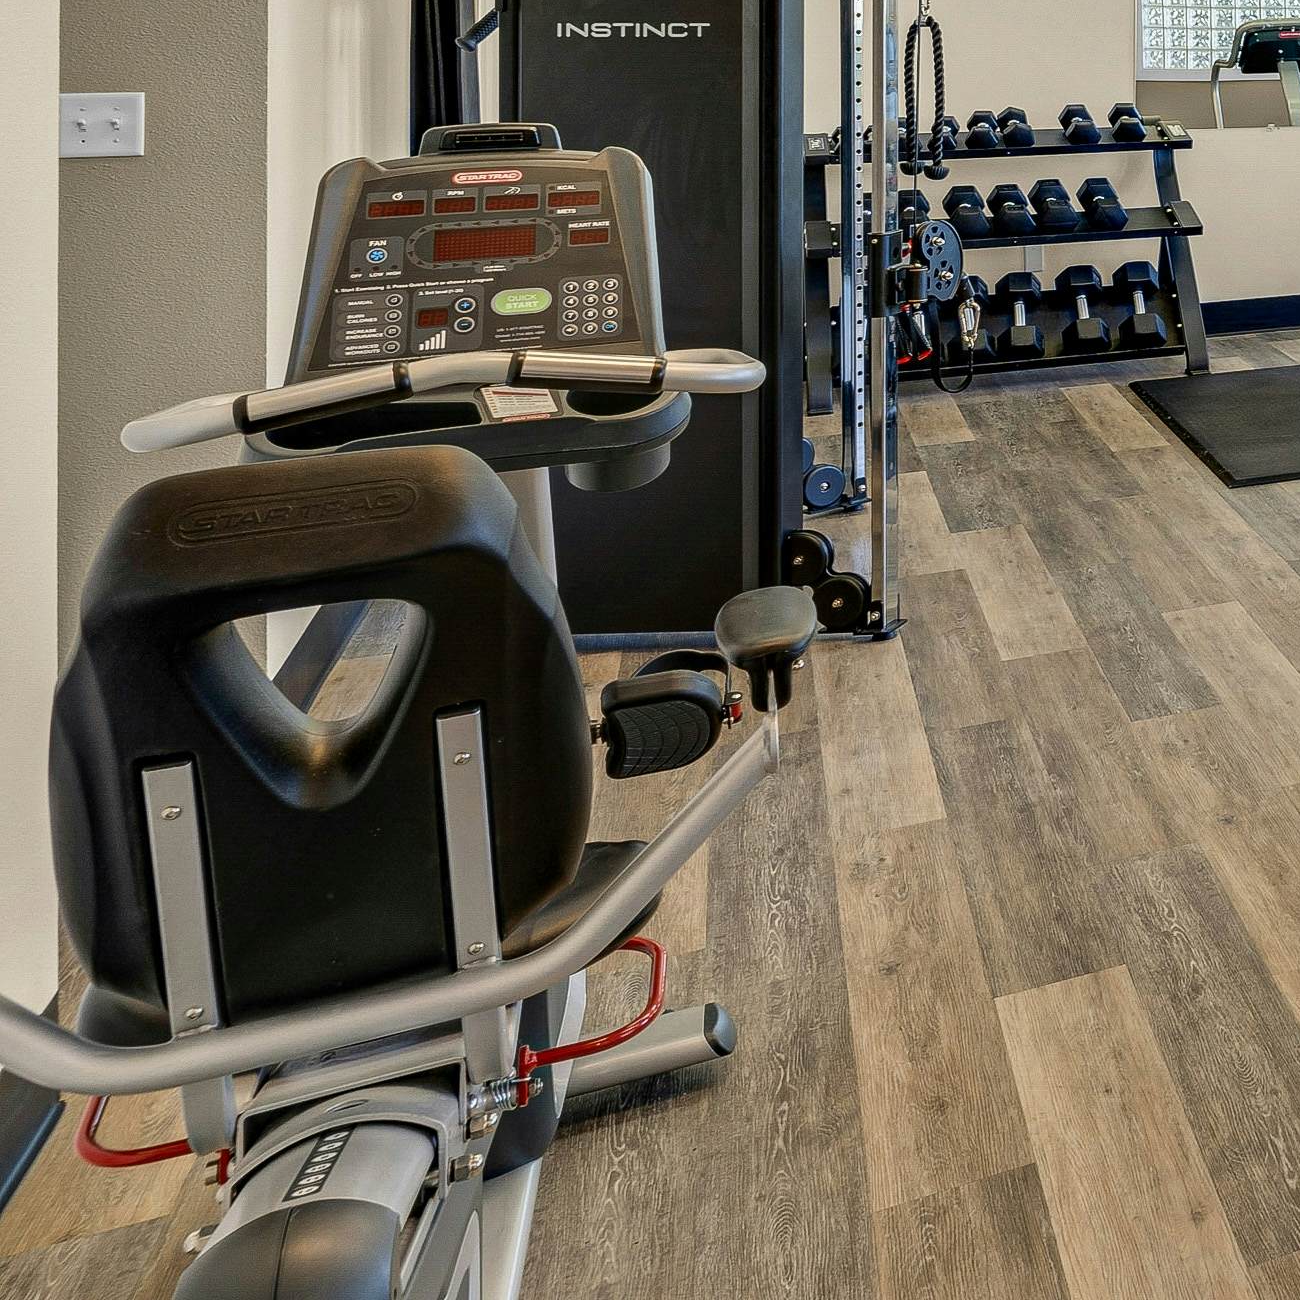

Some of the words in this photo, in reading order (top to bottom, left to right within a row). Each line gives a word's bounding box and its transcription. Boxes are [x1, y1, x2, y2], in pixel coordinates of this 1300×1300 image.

[557, 23, 710, 38] INSTINCT
[506, 301, 539, 309] START
[181, 505, 293, 534] STAR
